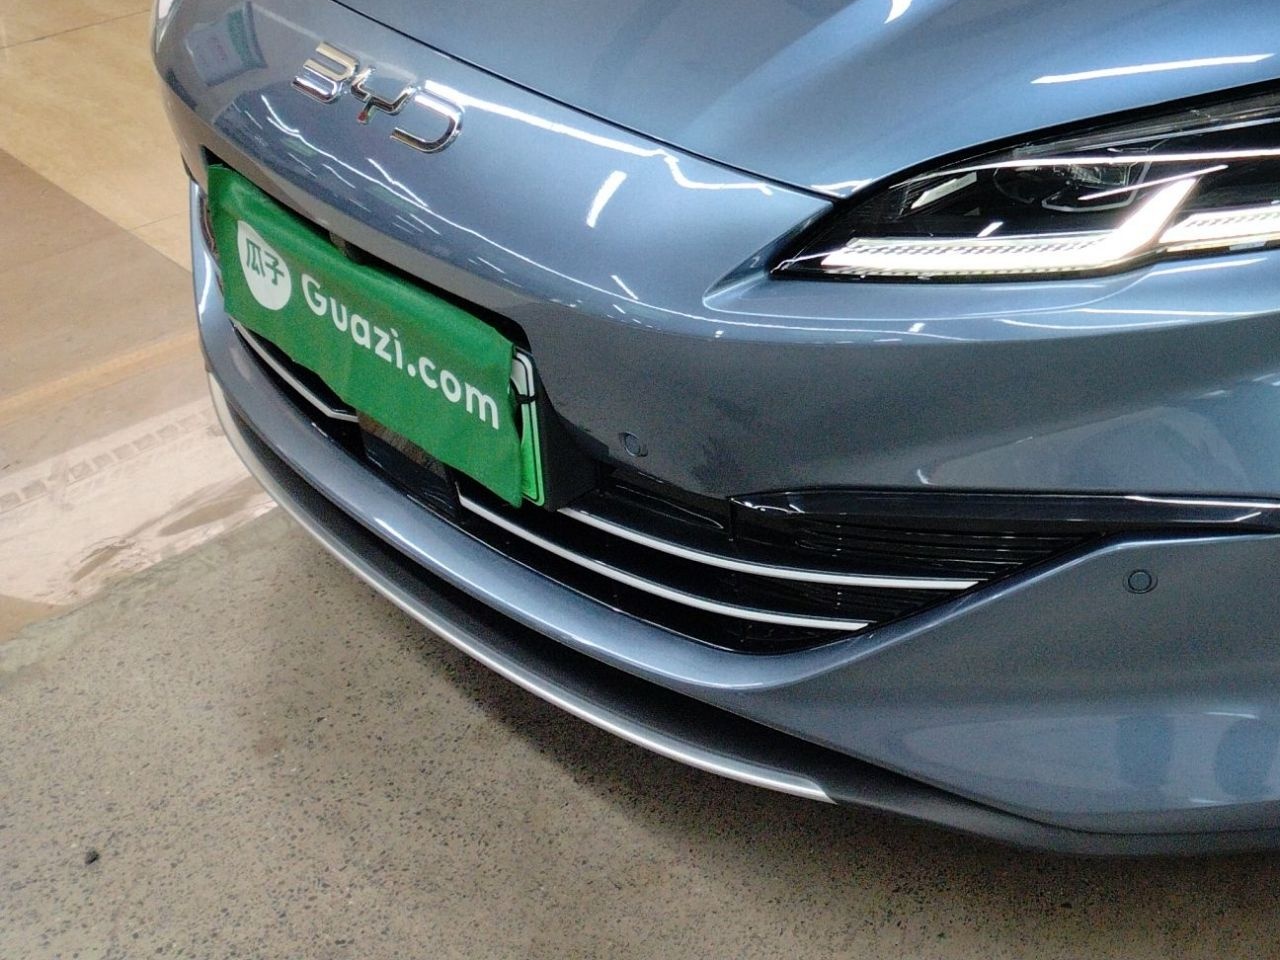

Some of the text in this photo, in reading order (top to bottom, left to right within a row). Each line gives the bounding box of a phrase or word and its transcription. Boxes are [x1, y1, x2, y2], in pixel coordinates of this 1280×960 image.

[290, 41, 465, 154] BYD
[245, 238, 500, 430] 瓜子 Guazi.com
